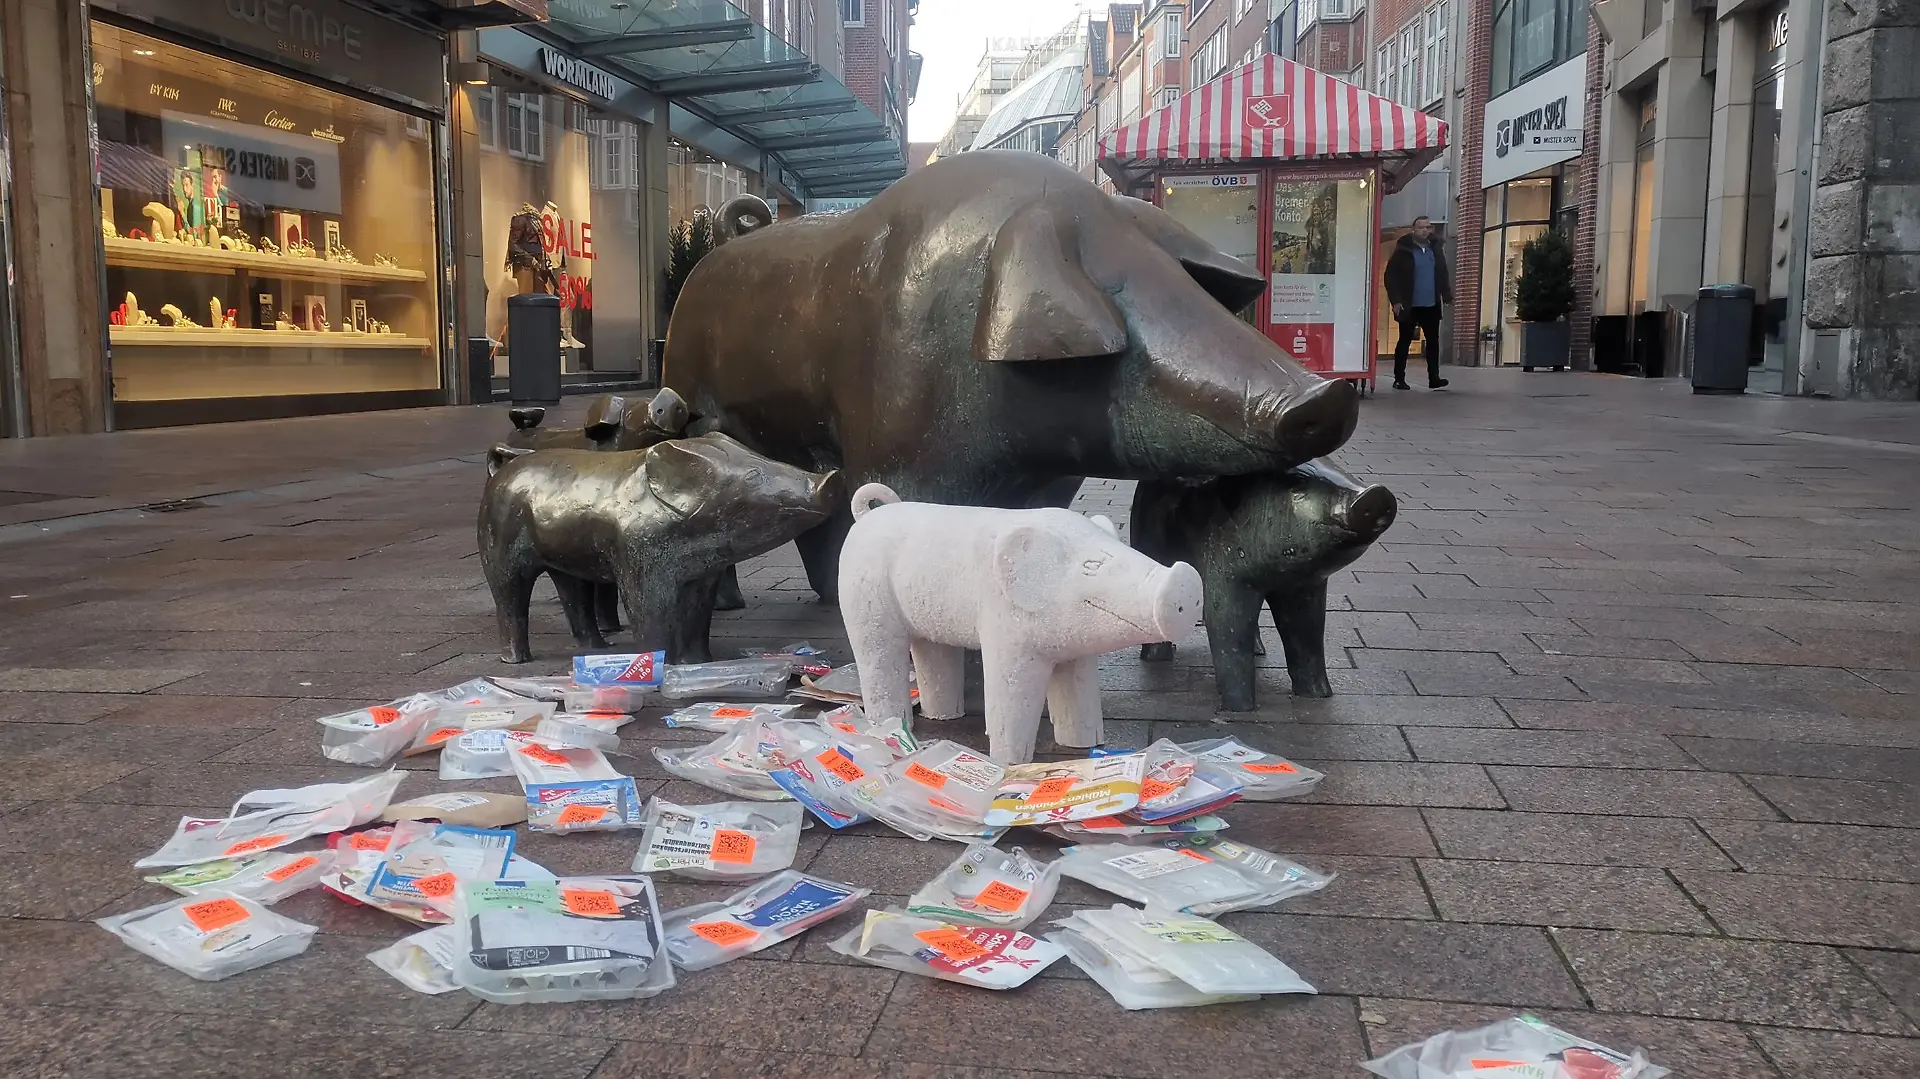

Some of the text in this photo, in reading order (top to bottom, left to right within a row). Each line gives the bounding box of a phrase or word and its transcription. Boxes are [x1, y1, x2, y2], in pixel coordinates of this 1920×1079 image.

[277, 39, 296, 53] SEIT
[541, 47, 616, 100] WORMLAND
[150, 83, 180, 100] BY KIM
[218, 98, 237, 112] IWC
[263, 110, 296, 131] Cartier
[1512, 95, 1568, 148] MISTER SPEX
[1212, 174, 1238, 186] ÖVB
[1276, 182, 1293, 193] Das
[1275, 208, 1304, 222] Konto.
[639, 667, 651, 680] GUT
[1067, 789, 1111, 802] Mühlen
[768, 899, 812, 921] NAPOLI
